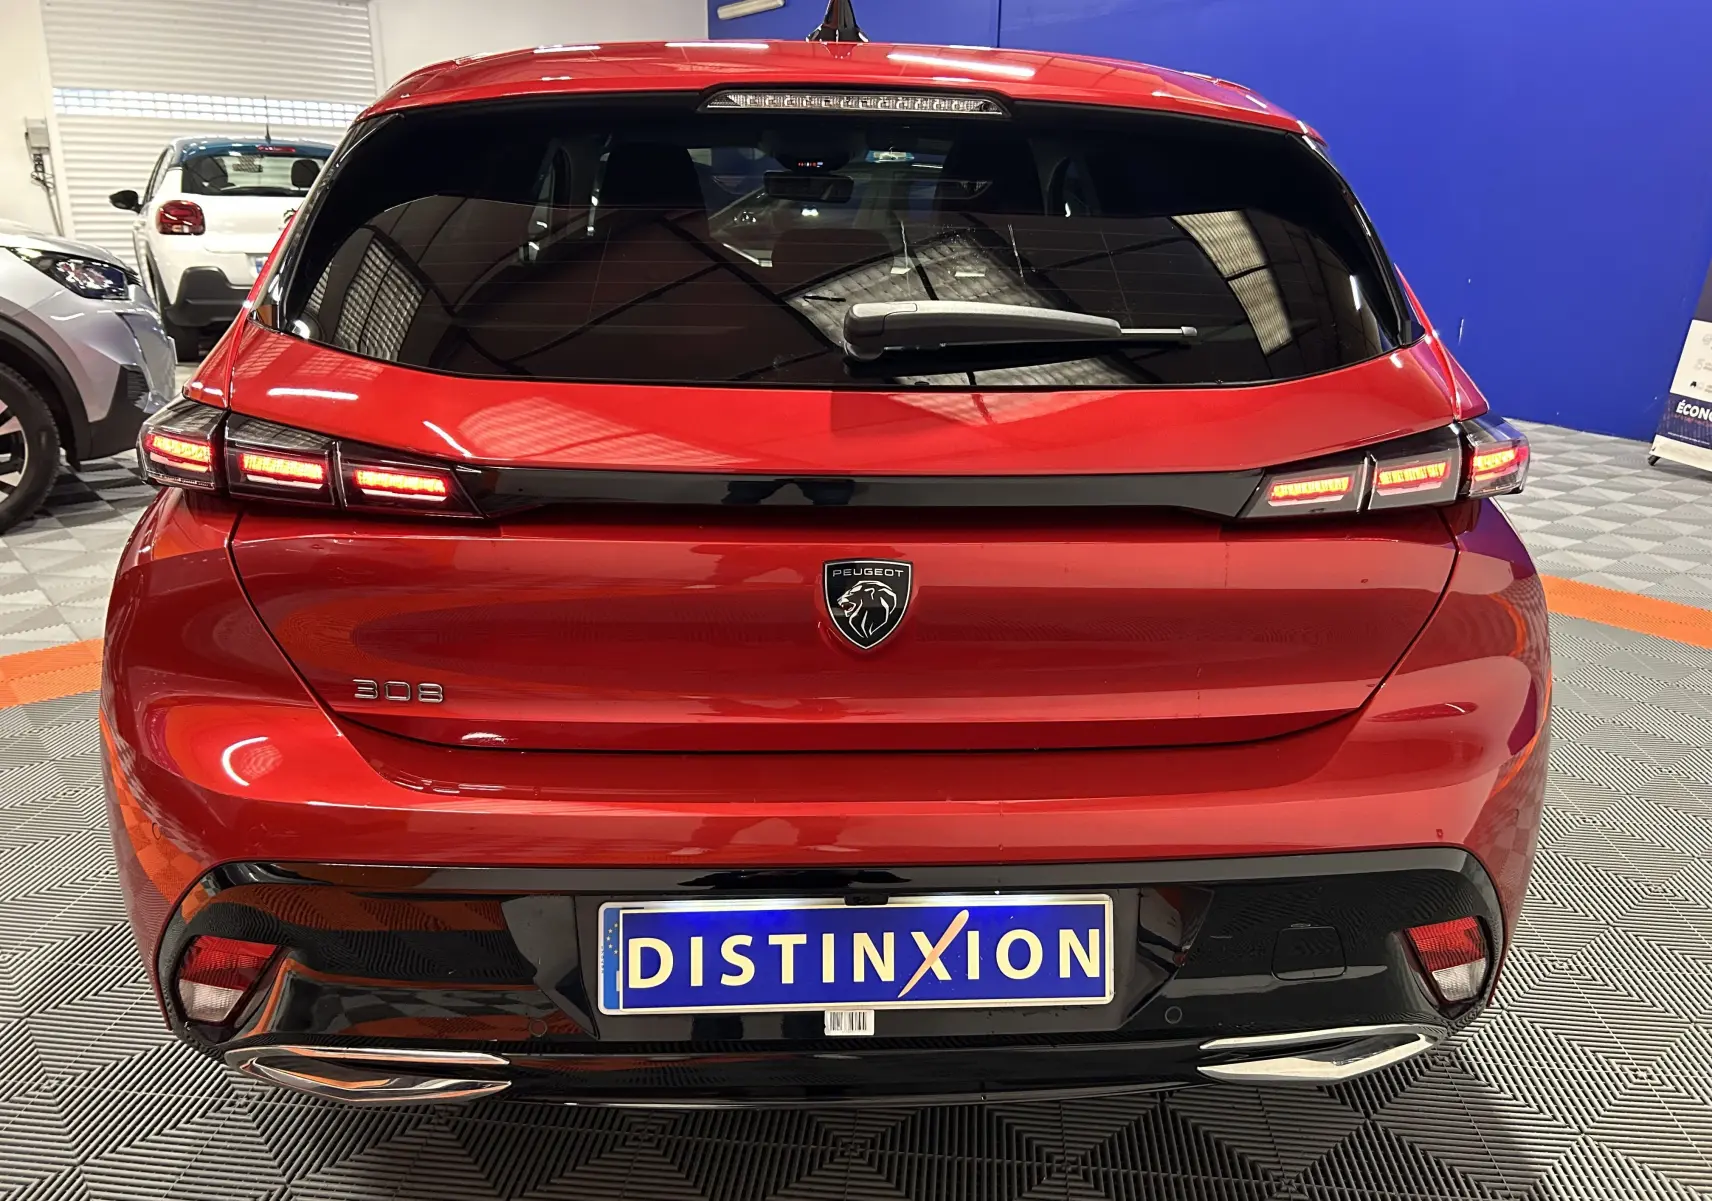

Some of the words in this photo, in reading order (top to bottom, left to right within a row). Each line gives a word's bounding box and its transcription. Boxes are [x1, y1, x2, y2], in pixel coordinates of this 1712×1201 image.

[832, 567, 904, 578] PEUGEOT
[352, 678, 444, 703] 308
[628, 909, 1100, 998] DISTINXION
